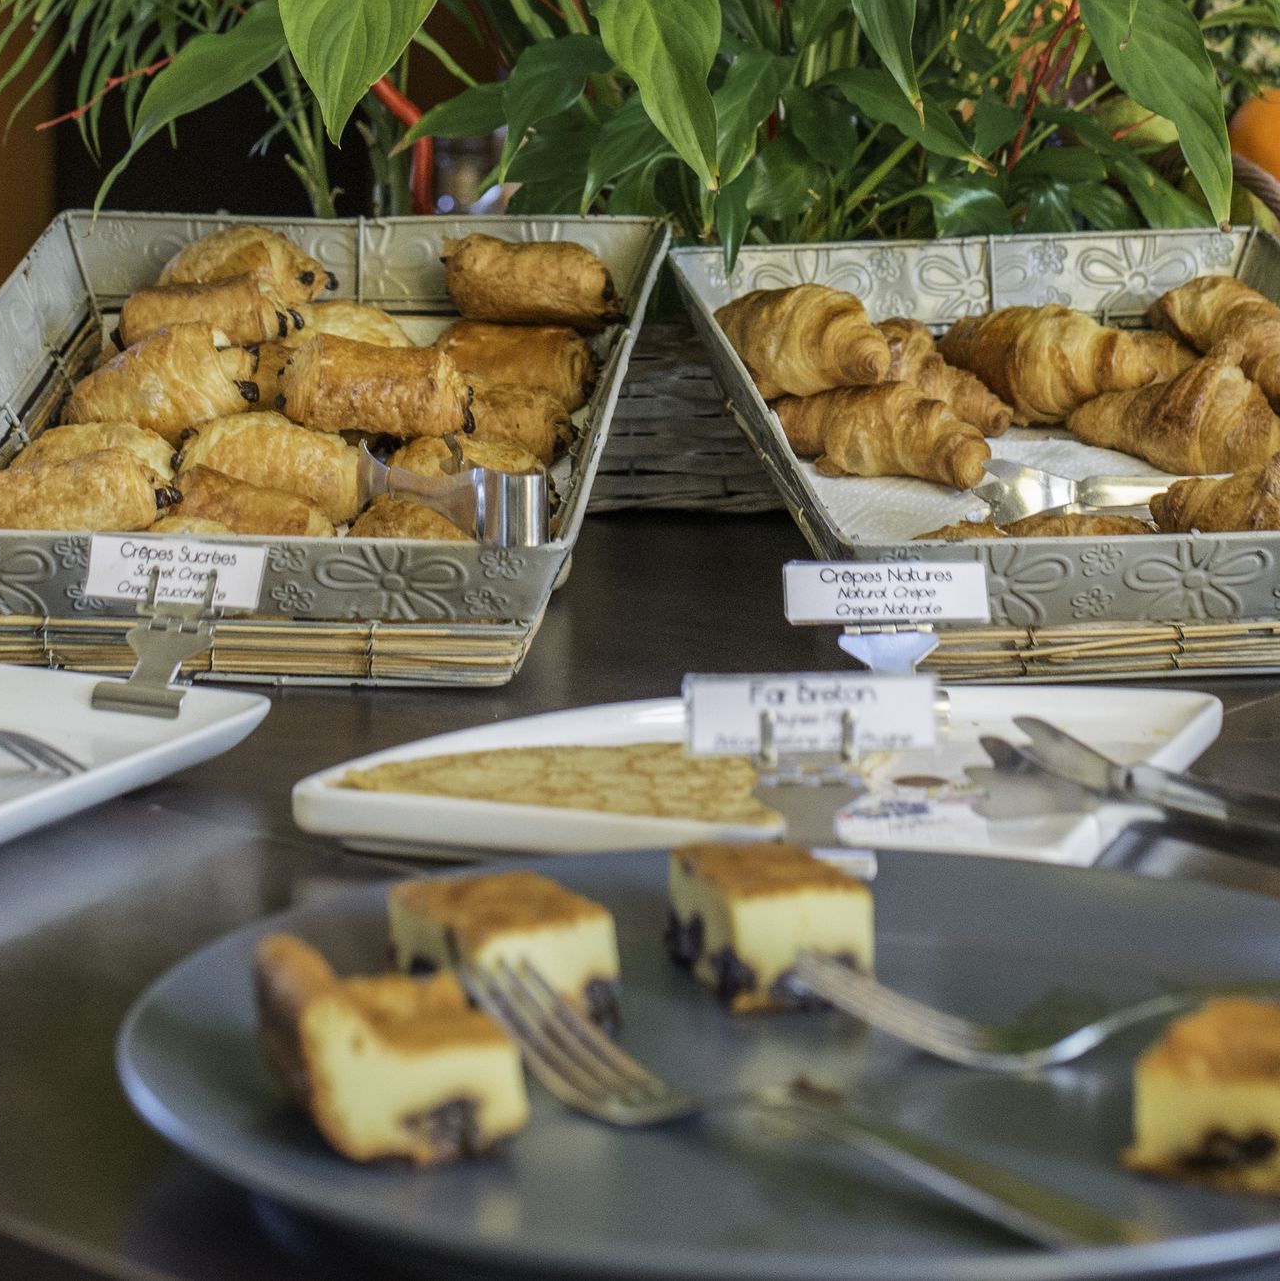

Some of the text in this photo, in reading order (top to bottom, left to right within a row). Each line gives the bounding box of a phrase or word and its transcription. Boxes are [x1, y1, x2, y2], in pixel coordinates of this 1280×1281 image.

[120, 541, 238, 567] Crêpes Sucrées
[819, 567, 953, 586] Crêpes Natures
[837, 586, 888, 600] Natural
[882, 603, 943, 617] Naturale
[749, 679, 878, 706] Far Breton
